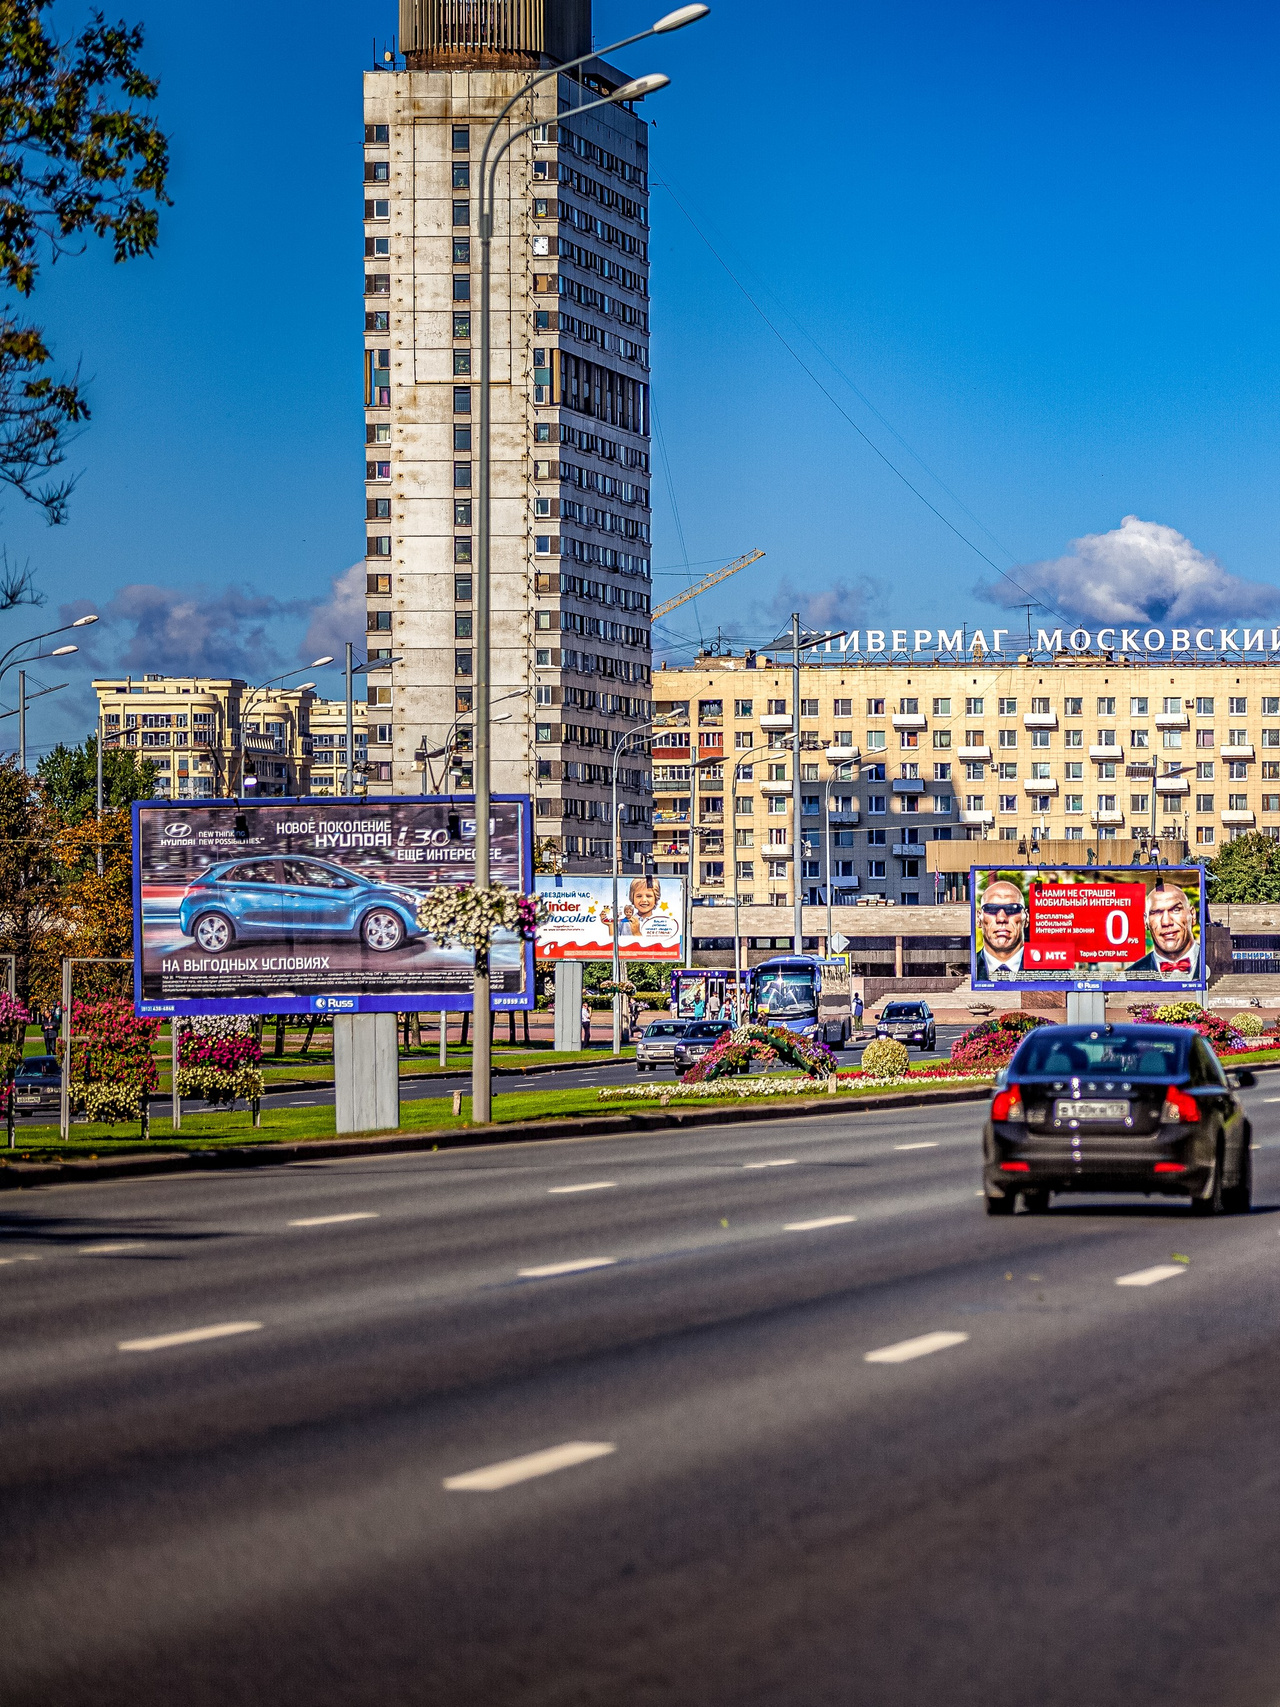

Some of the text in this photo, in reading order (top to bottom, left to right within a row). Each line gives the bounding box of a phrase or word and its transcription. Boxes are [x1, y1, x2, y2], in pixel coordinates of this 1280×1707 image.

[787, 630, 1008, 653] НИВЕРМАГ
[276, 820, 392, 835] НОВОЕ ПОКОЛЕНИЕ
[161, 838, 196, 846] HYUNDAI
[198, 838, 214, 846] NEW
[315, 833, 392, 848] HYUNDAI
[397, 848, 502, 862] ЕЩЕ ИНТЕРЕСЕЕ
[540, 891, 591, 899] ЗВЕЗДНЫЙ ЧАС
[1042, 889, 1066, 897] НАМИ
[1067, 889, 1078, 897] НЕ
[1079, 889, 1116, 897] СТРАШЕН
[1035, 897, 1131, 907] МОБИЛЬНЫЙ ИНТЕРНЕТ!
[547, 913, 597, 923] hocolate
[1035, 919, 1073, 927] мобильный
[1106, 909, 1129, 945] 0
[1045, 951, 1067, 960] МТС
[162, 956, 330, 974] НА ВЫГОДНЫХ УСЛОВИЯХ
[328, 999, 354, 1008] Russ
